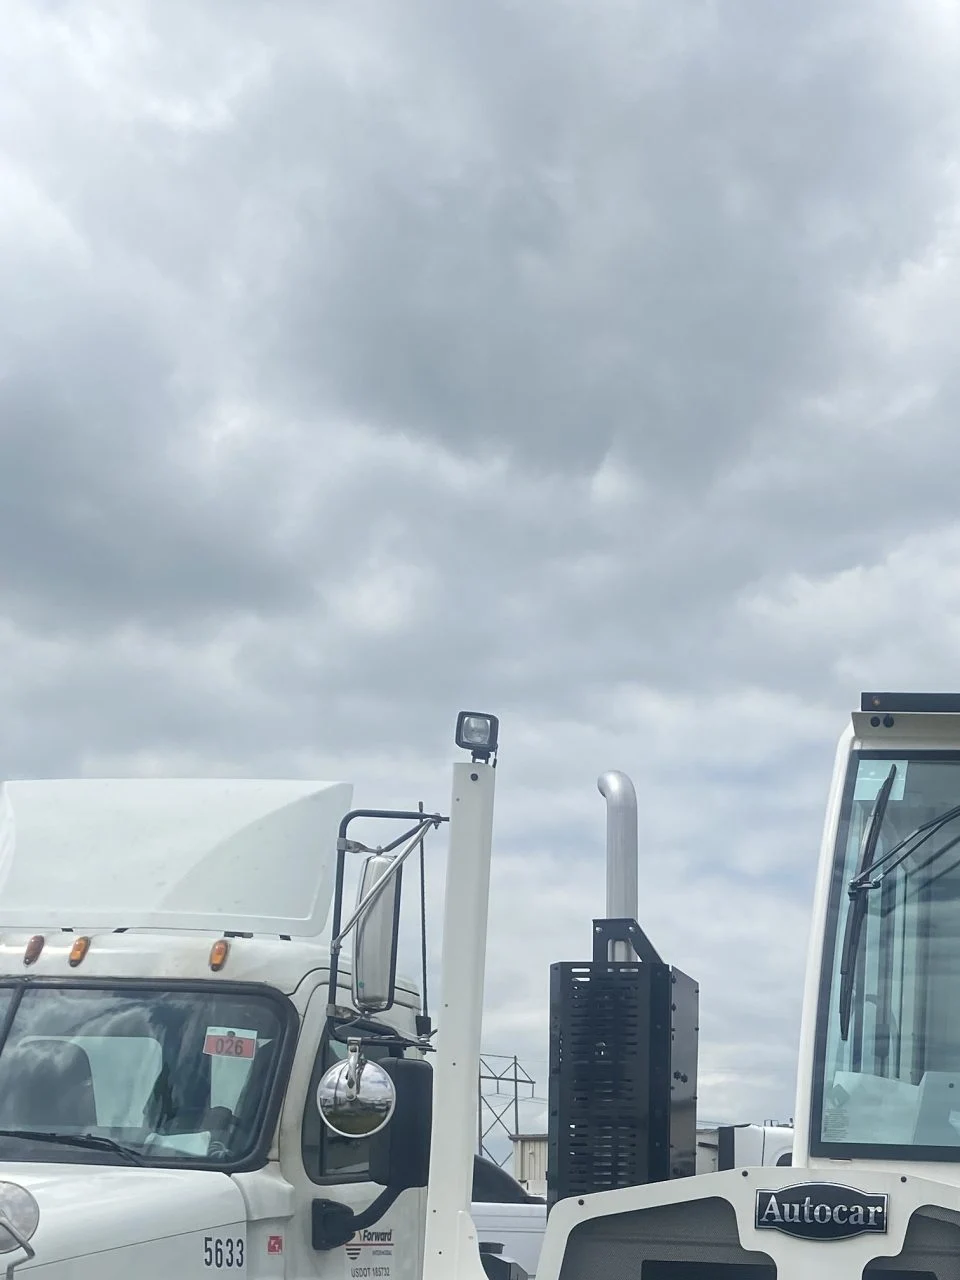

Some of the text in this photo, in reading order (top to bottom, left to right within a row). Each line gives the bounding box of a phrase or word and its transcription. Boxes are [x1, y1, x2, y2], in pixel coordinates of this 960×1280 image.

[215, 1038, 244, 1055] 026
[759, 1195, 883, 1226] Autocar
[363, 1229, 393, 1242] Forward
[204, 1236, 244, 1268] 5633
[351, 1267, 371, 1278] USDOT
